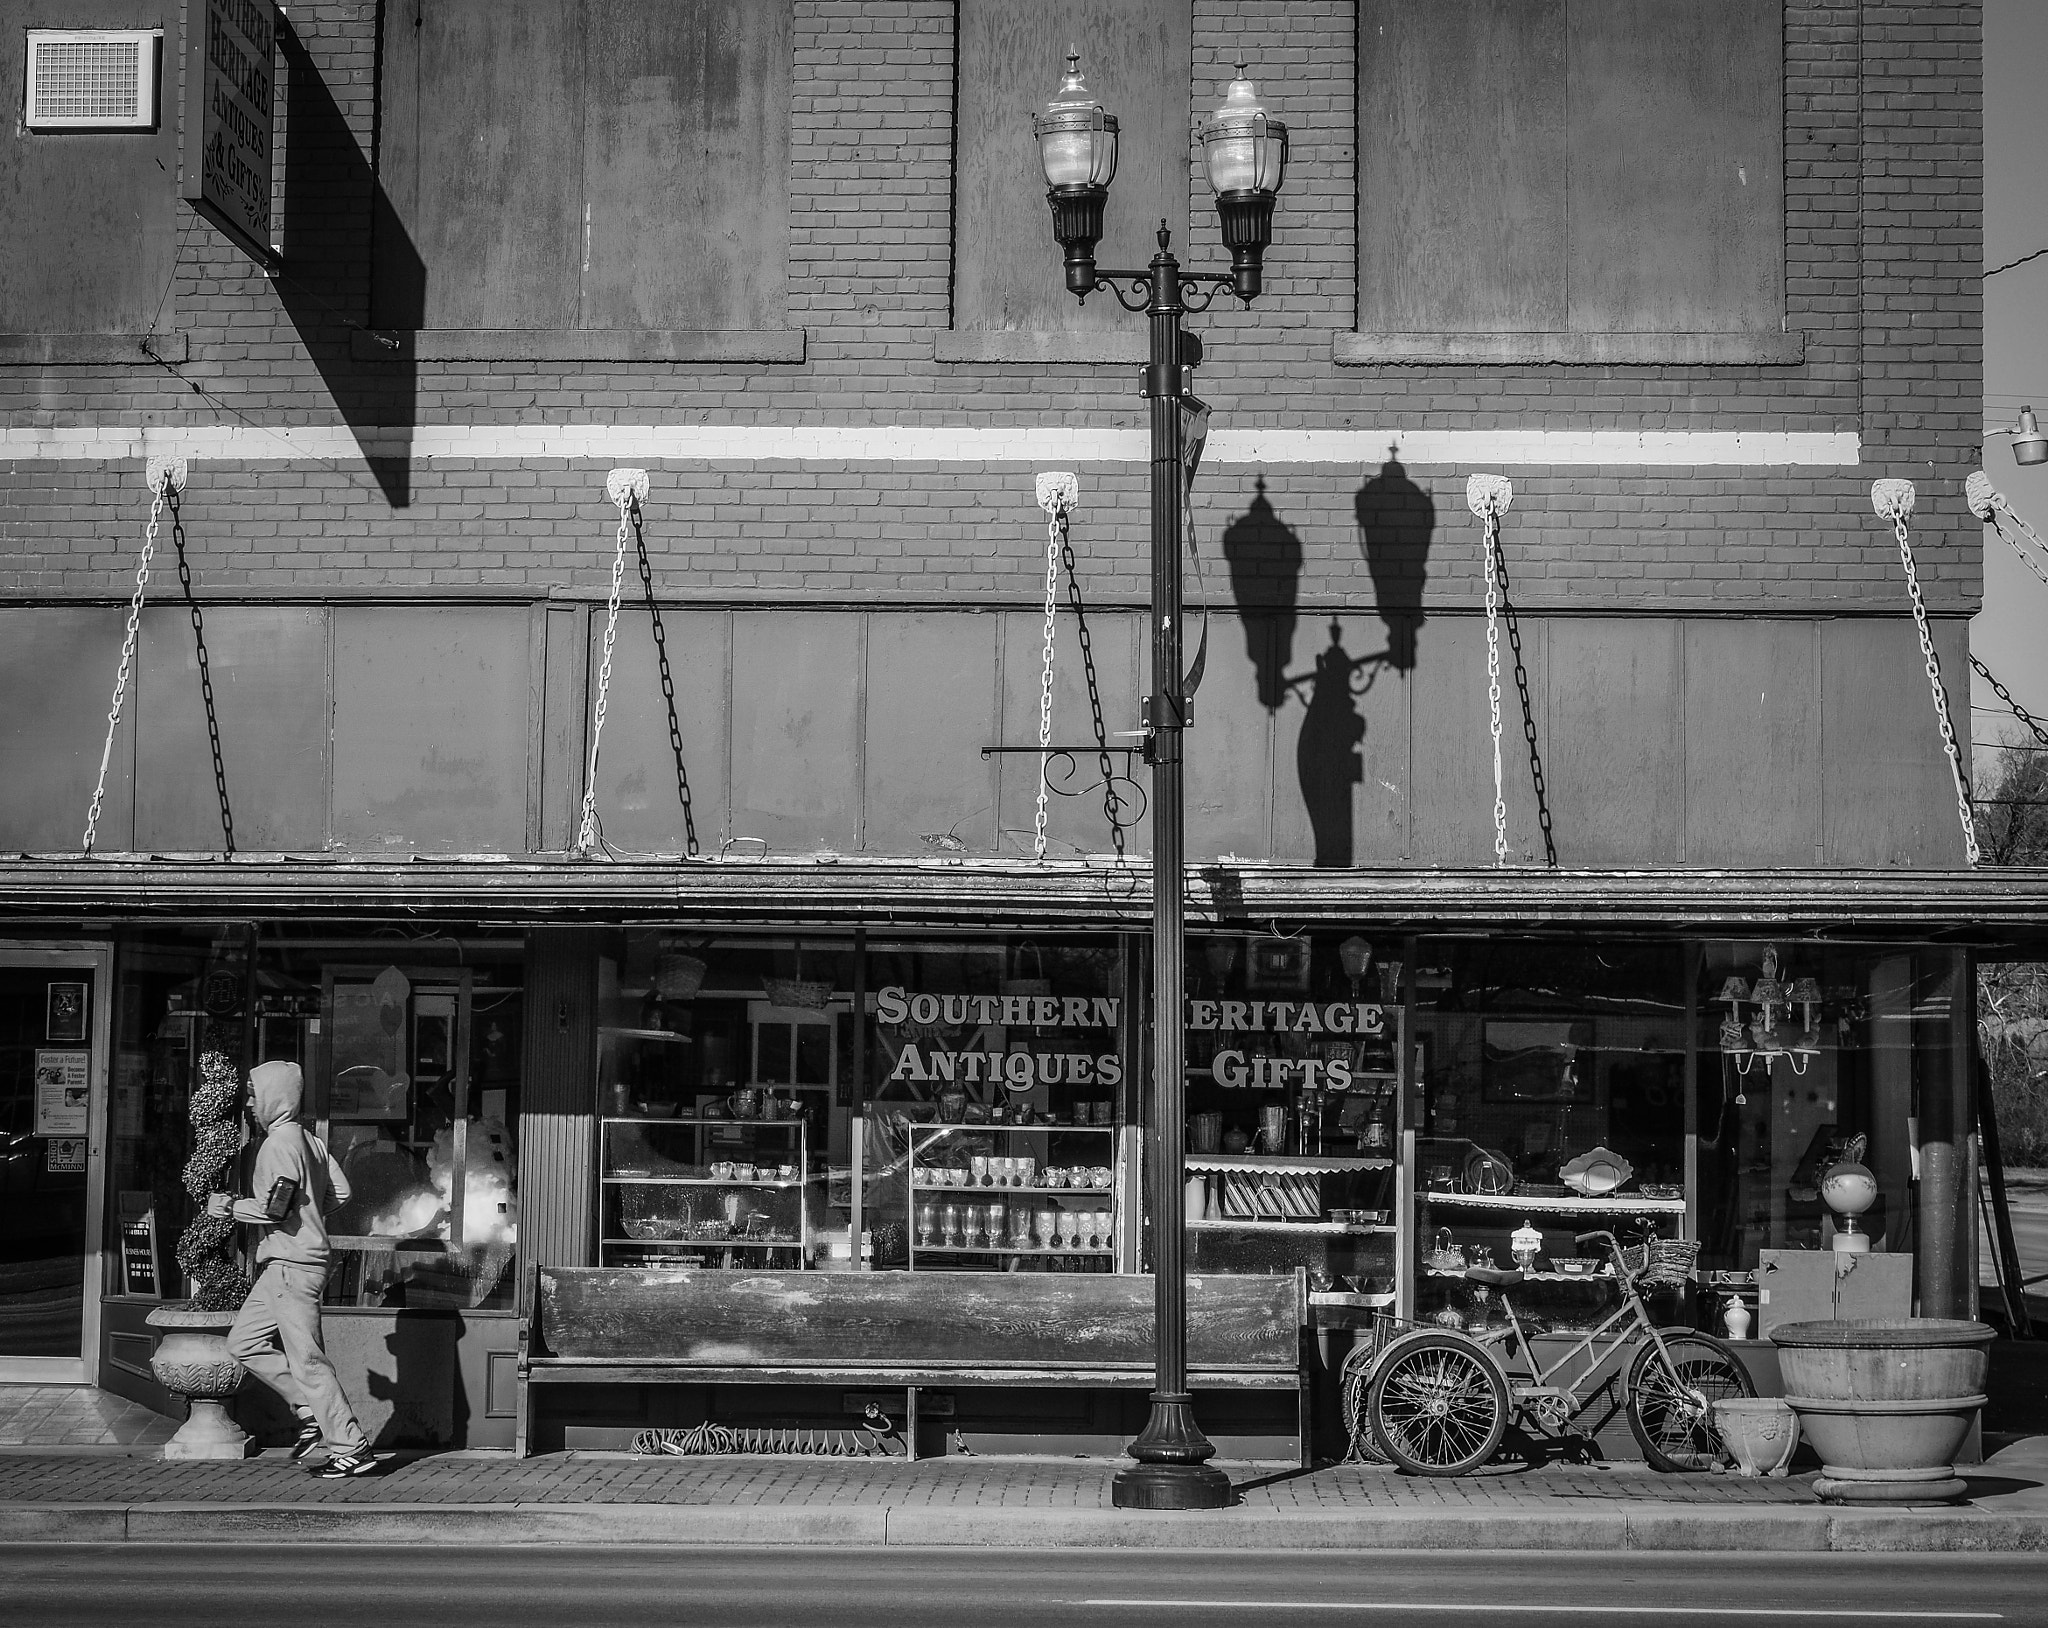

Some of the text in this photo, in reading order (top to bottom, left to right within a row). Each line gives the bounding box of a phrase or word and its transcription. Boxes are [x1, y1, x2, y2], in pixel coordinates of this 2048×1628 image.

[210, 9, 268, 118] HERITAGE
[212, 78, 264, 160] ANTIQUES
[215, 131, 260, 203] & GIFTS
[877, 985, 1384, 1034] SOUTHERN ERITAGE
[40, 1055, 59, 1064] Foster
[65, 1055, 86, 1064] Future!
[891, 1043, 1123, 1092] ANTIQUES
[1212, 1050, 1353, 1091] GIFTS
